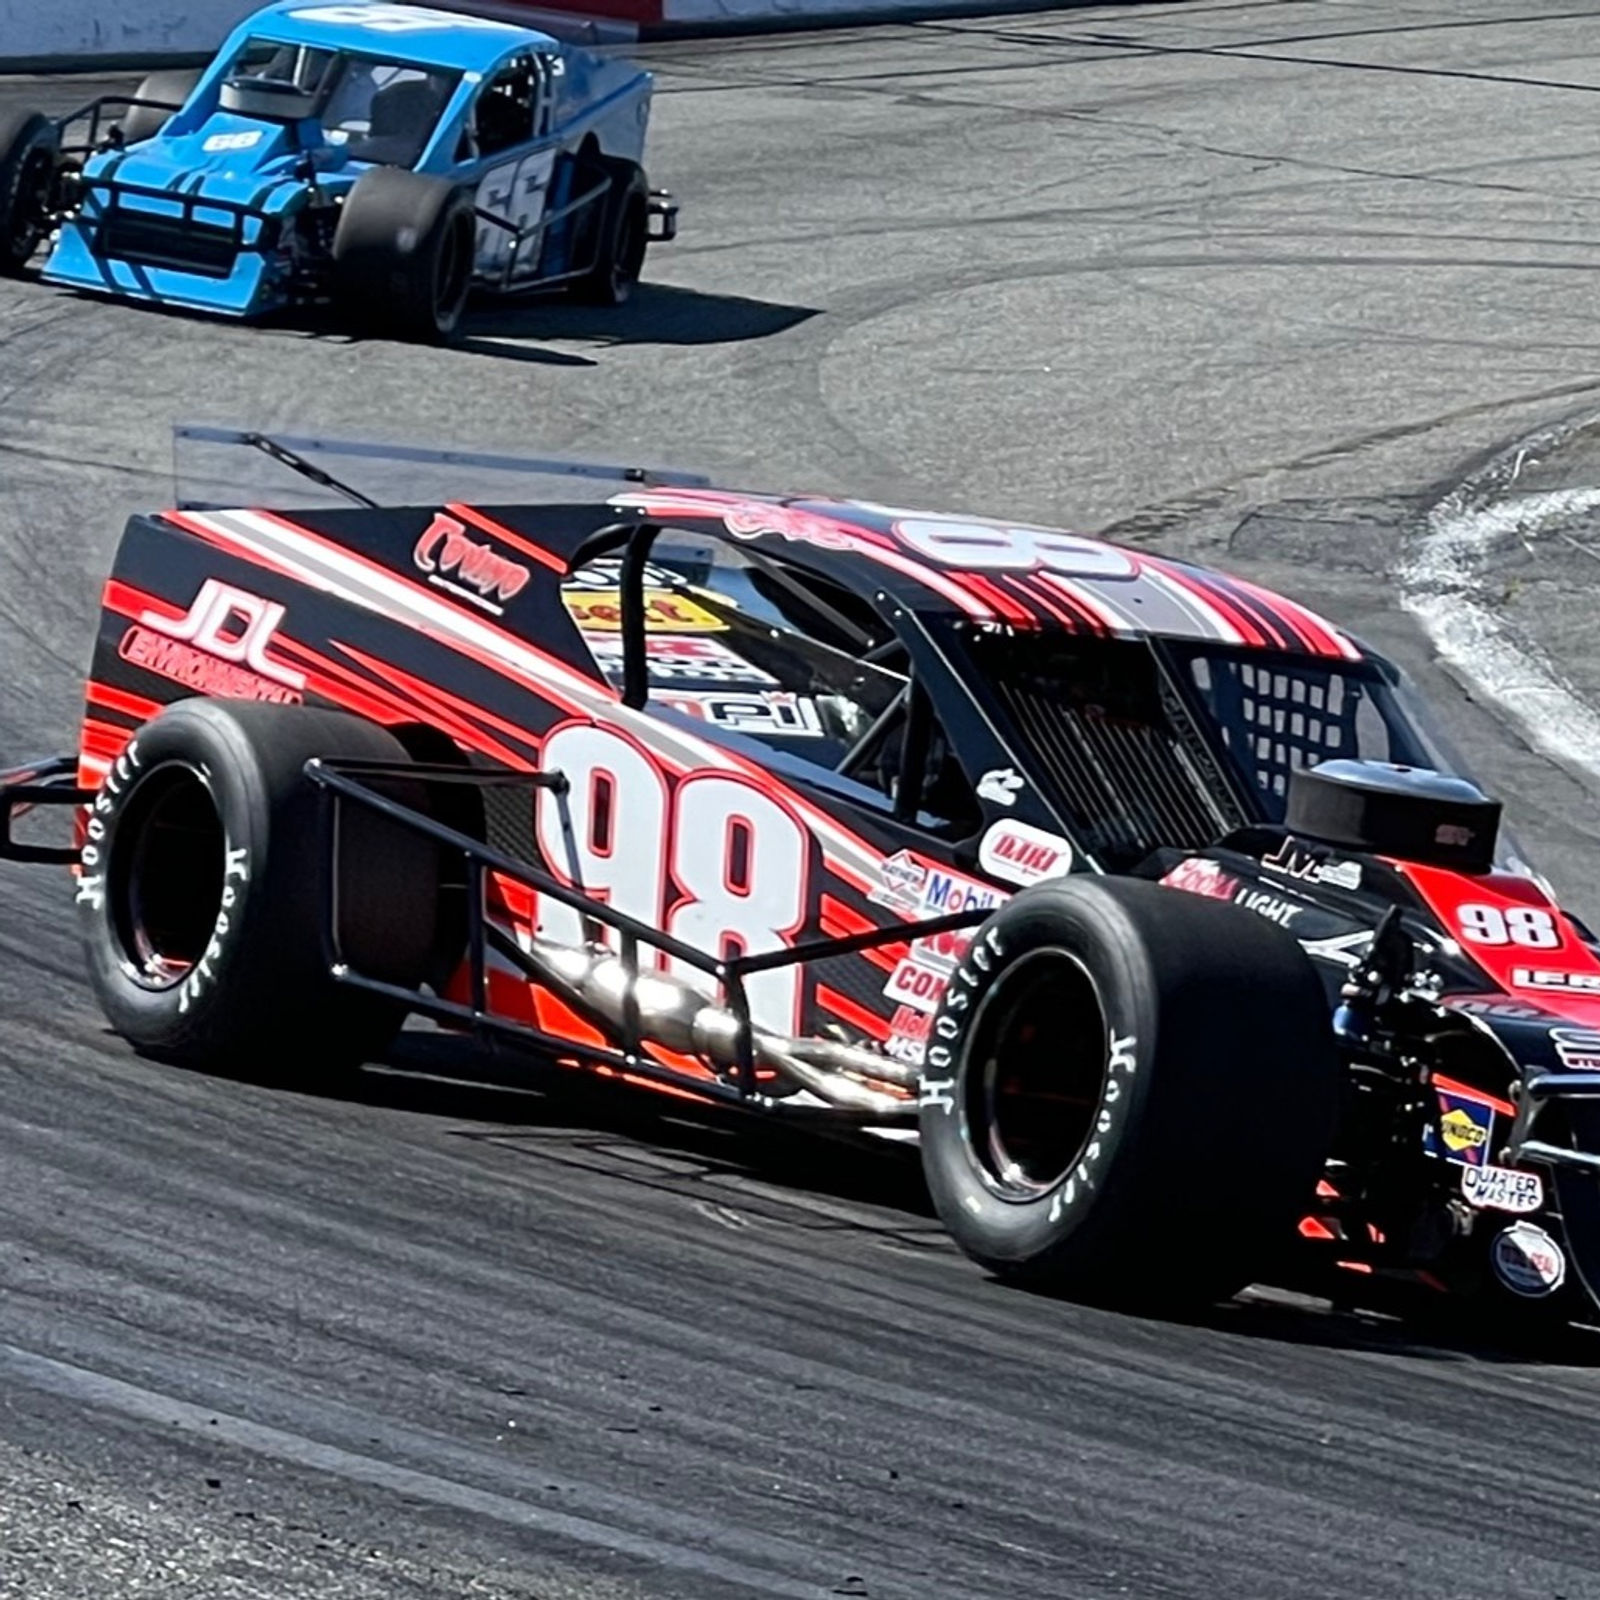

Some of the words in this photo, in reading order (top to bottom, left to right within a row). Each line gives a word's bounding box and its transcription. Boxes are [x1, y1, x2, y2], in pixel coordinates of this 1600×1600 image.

[140, 577, 286, 691] JDL
[535, 718, 810, 1042] 98
[1456, 903, 1560, 949] 98
[1464, 1167, 1537, 1193] QUARTER
